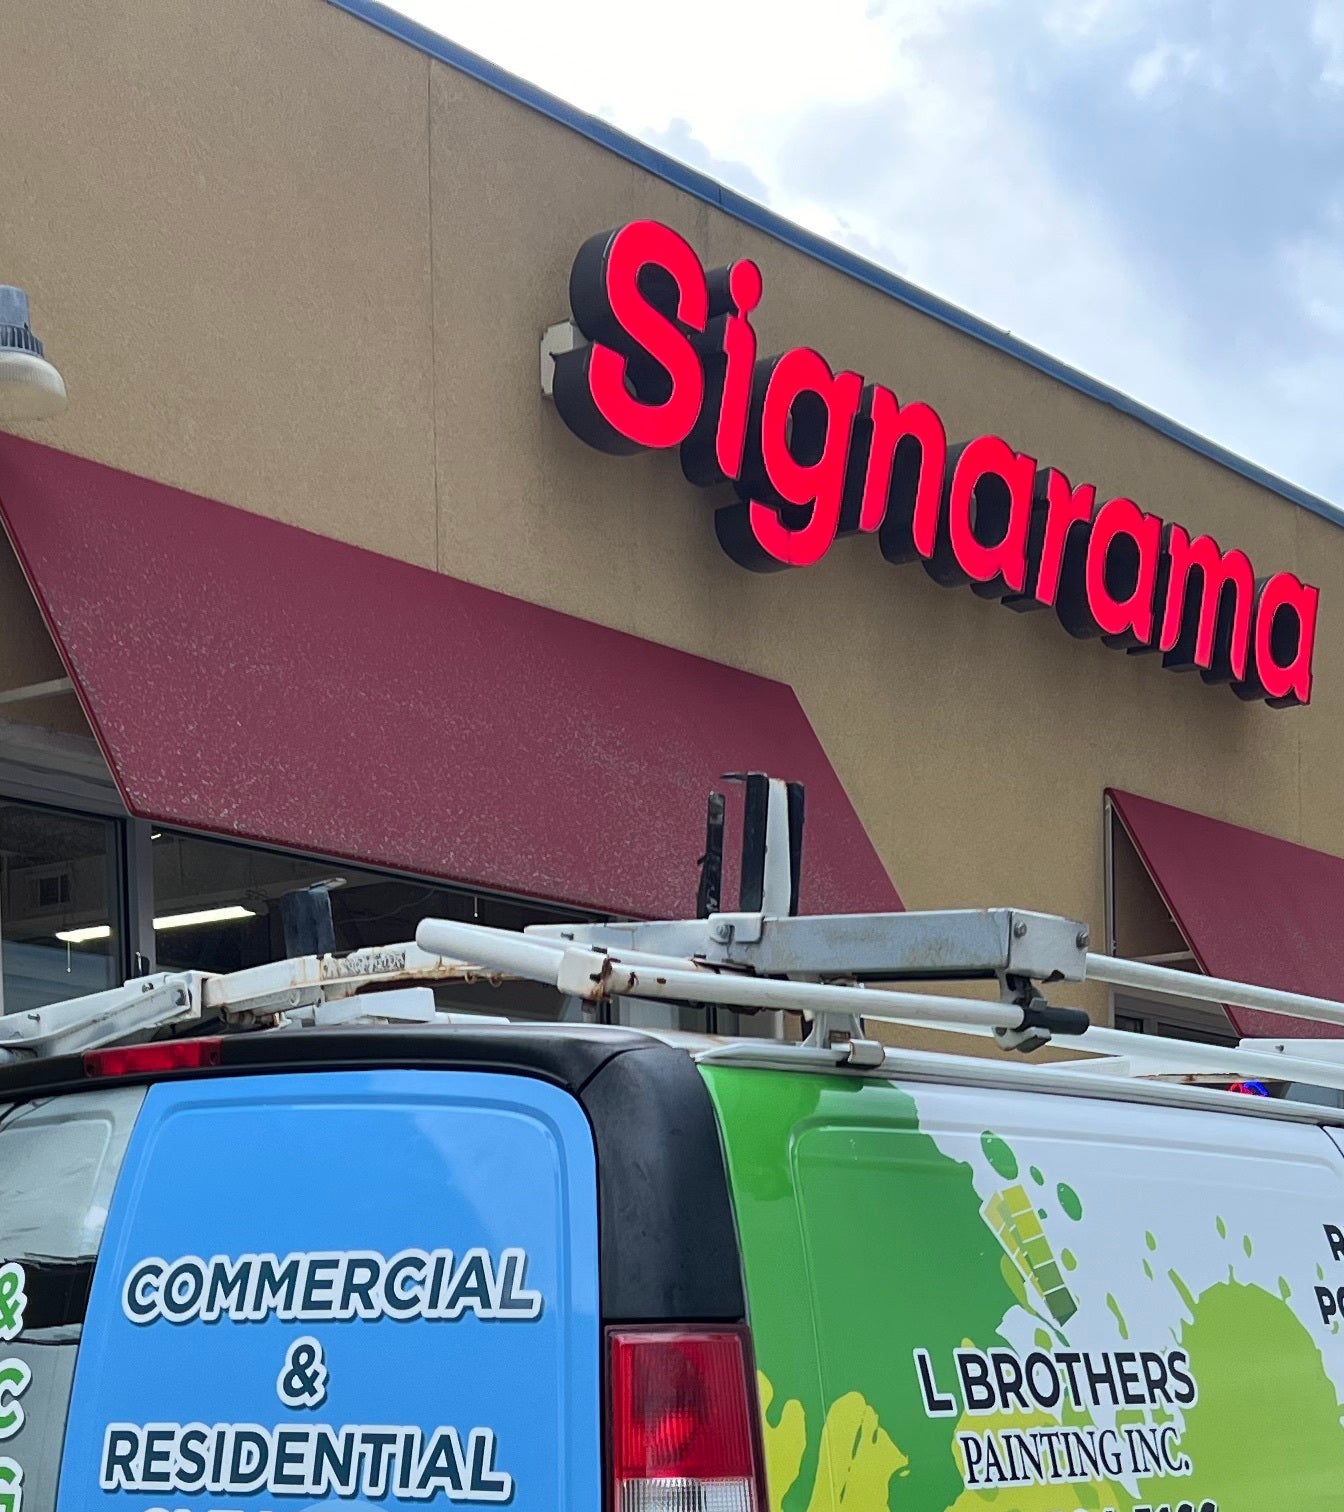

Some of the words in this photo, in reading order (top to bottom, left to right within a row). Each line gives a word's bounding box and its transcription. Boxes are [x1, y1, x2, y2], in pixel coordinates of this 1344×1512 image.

[584, 217, 1321, 706] Signarama
[124, 1252, 538, 1319] COMMERCIAL
[280, 1340, 324, 1403] &
[915, 1350, 956, 1415] L
[956, 1349, 1198, 1414] BROTHERS
[102, 1427, 513, 1498] RESIDENTIAL
[958, 1428, 1124, 1486] PAINTING
[1123, 1425, 1192, 1477] INC.
